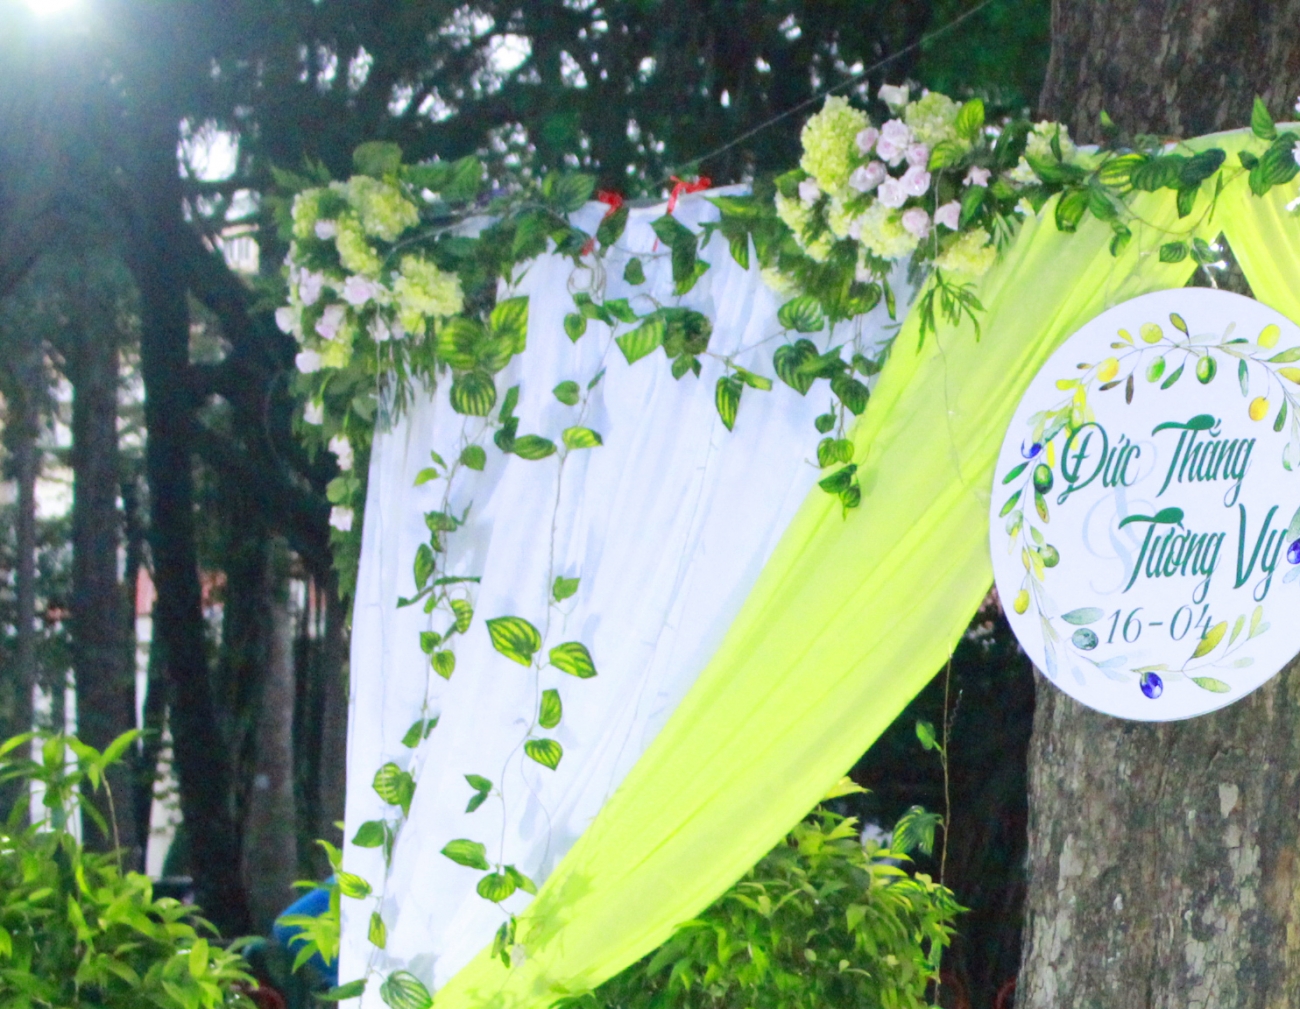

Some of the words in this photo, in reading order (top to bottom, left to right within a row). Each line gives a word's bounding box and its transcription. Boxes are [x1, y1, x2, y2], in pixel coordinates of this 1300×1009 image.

[1057, 422, 1141, 505] Đức
[1151, 414, 1257, 508] Thắng
[1118, 506, 1226, 605] Tường
[1233, 503, 1288, 602] Vy
[1106, 603, 1214, 645] 16-04
